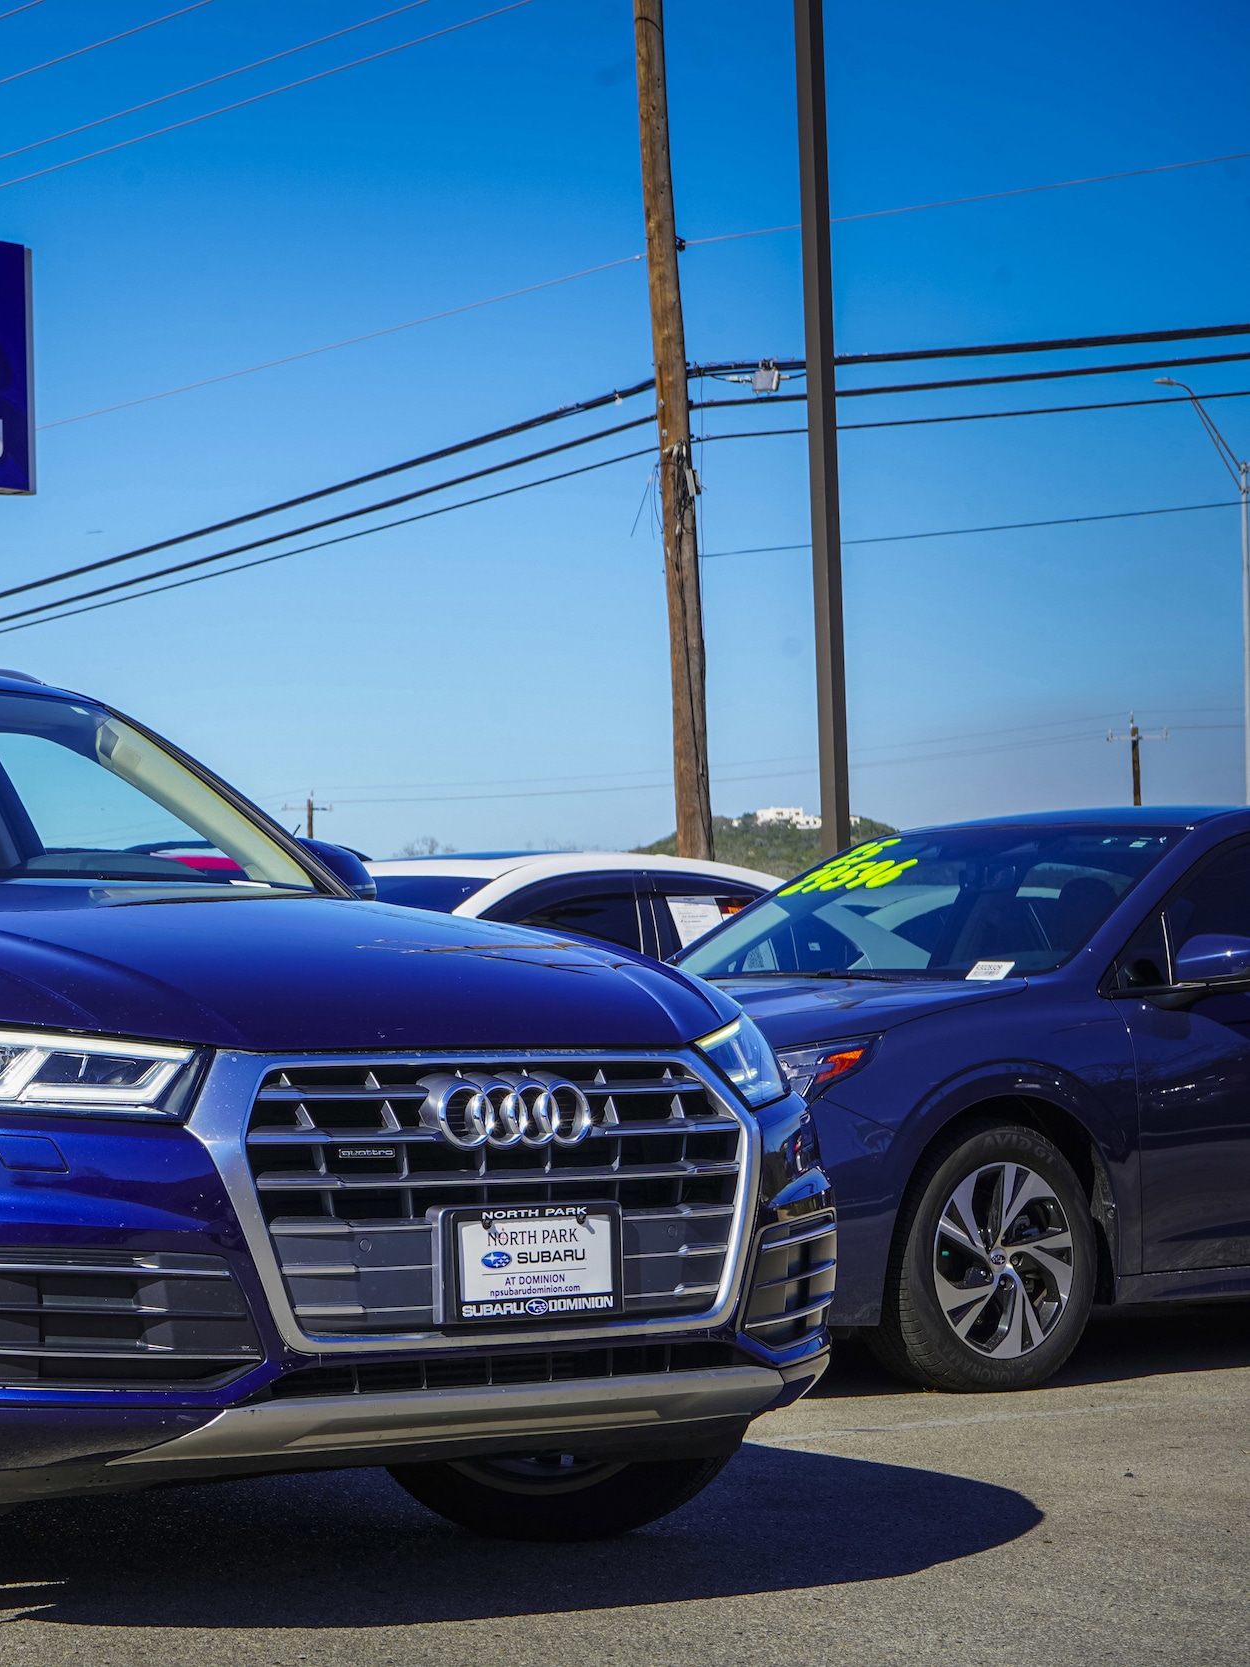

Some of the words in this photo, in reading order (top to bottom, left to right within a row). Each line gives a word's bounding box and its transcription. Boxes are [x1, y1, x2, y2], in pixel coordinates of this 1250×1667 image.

[341, 1149, 394, 1157] quattro
[482, 1208, 540, 1221] NORTH
[545, 1206, 588, 1217] PARK
[487, 1229, 538, 1247] NORTH
[542, 1227, 580, 1244] PARK
[517, 1248, 586, 1264] SUBARU
[504, 1276, 517, 1286] AT
[519, 1274, 566, 1285] DOMINION
[490, 1284, 581, 1298] npsubarudominion.com
[462, 1301, 525, 1318] SUBARU
[548, 1295, 614, 1312] DOMINION
